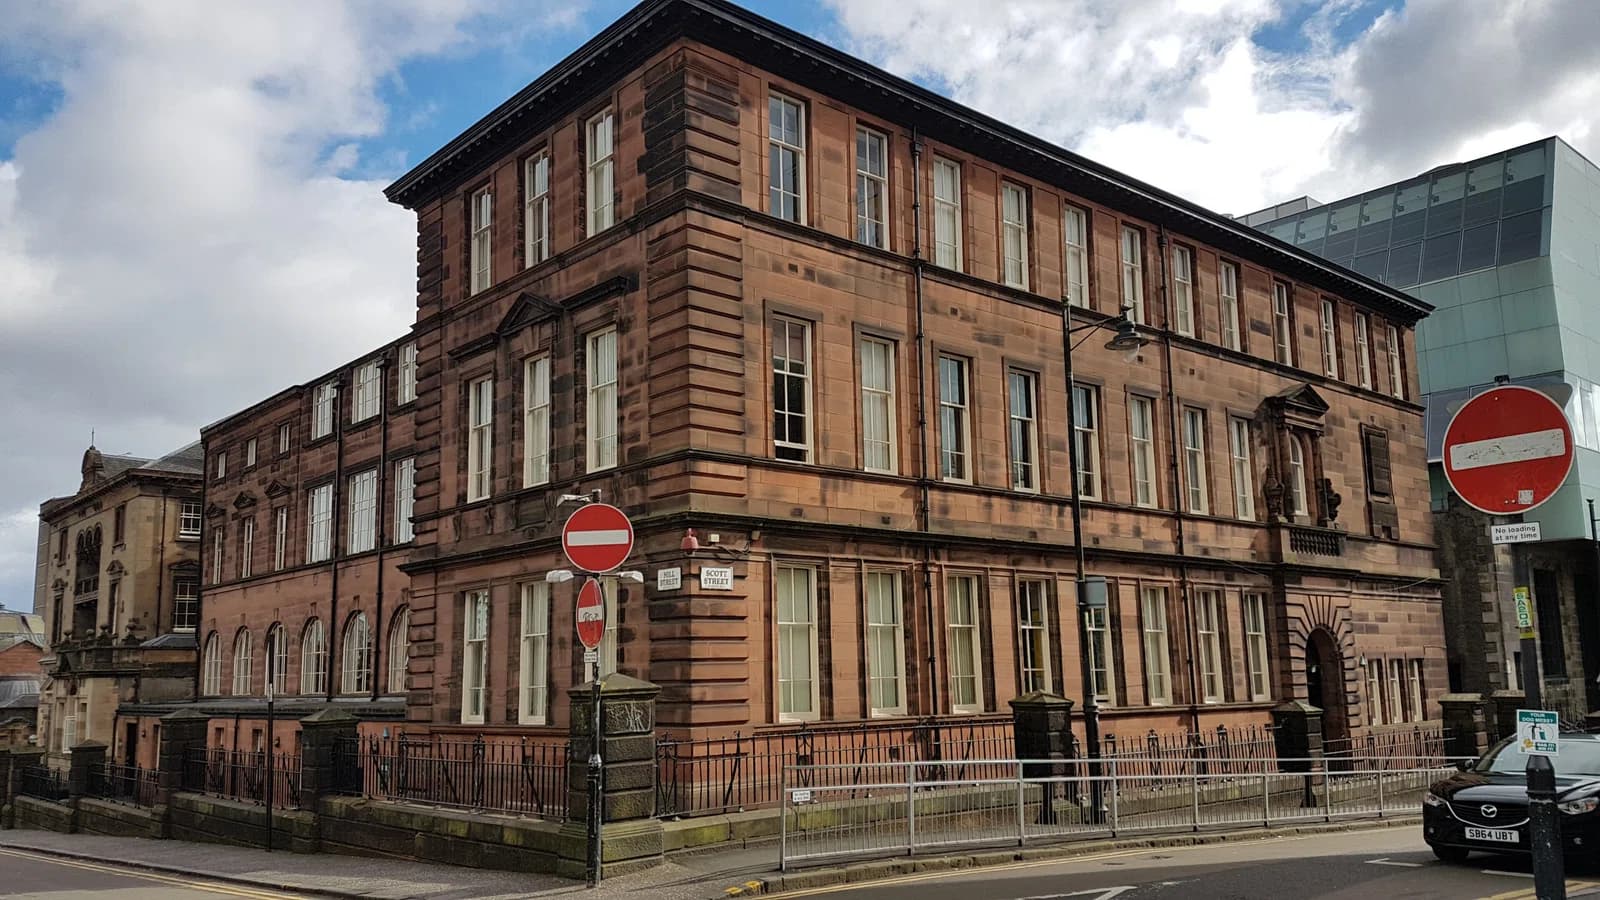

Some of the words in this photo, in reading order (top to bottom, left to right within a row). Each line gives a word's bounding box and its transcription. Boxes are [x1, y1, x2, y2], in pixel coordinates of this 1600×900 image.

[705, 569, 729, 578] SCOTT
[660, 577, 679, 587] STREET
[703, 577, 729, 585] STREET
[1469, 828, 1493, 839] SB64
[1495, 831, 1514, 841] UBT
